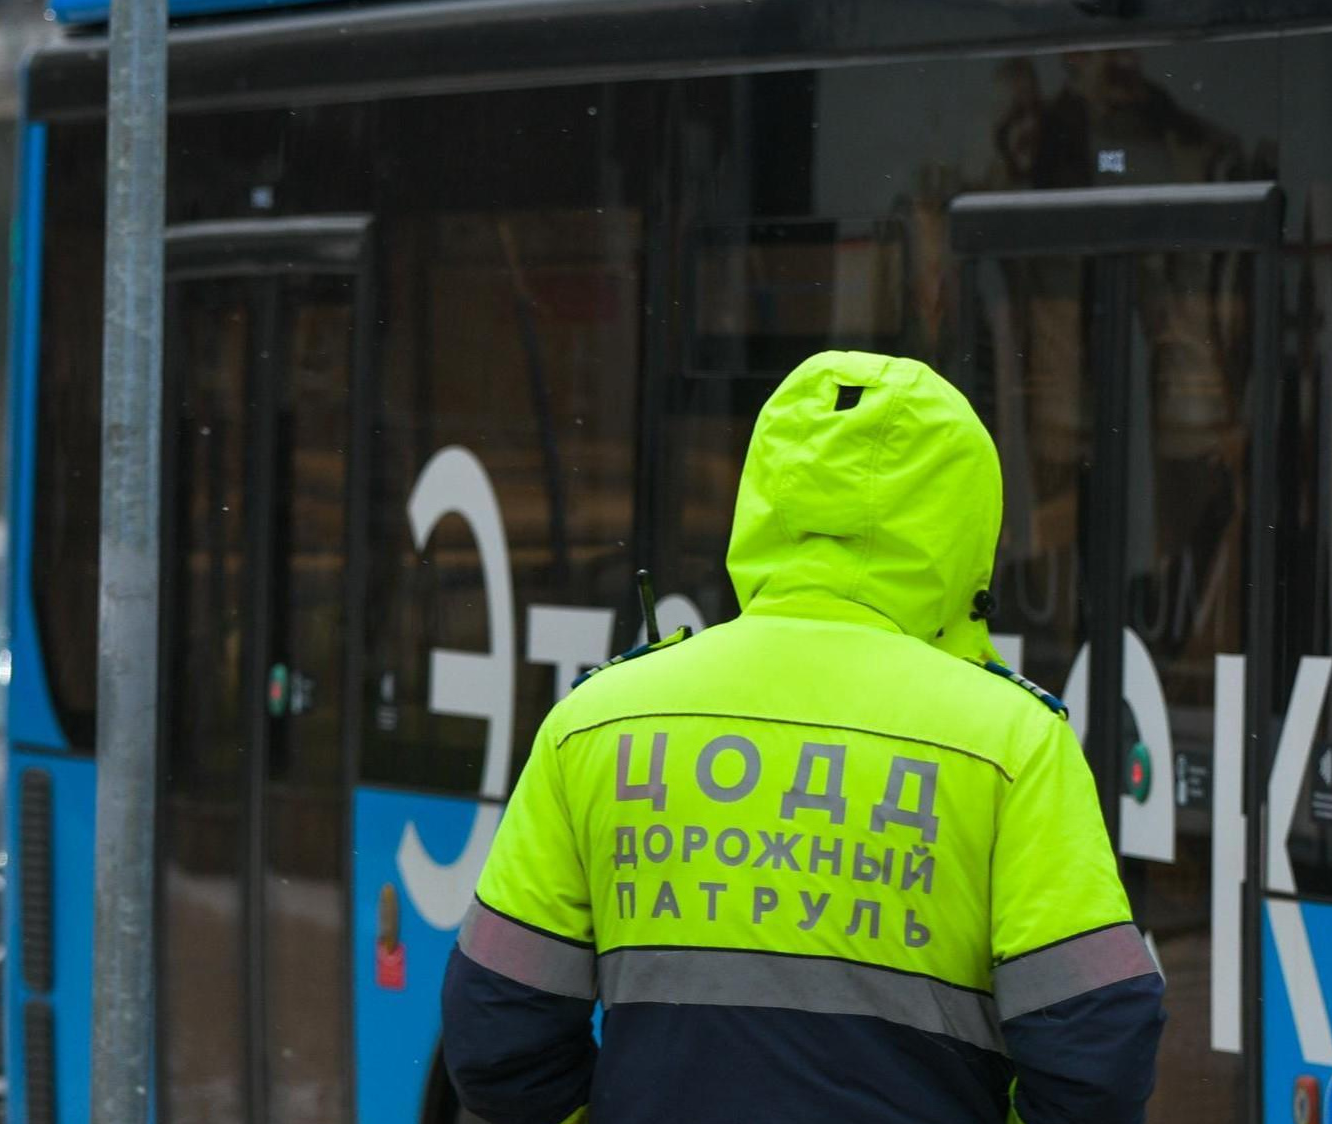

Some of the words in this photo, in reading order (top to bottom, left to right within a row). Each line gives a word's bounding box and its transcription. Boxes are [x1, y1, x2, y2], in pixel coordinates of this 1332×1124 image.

[615, 731, 939, 844] ЦОДД
[613, 823, 936, 895] ДОРОЖНЫЙ
[615, 881, 931, 948] ПАТРУЛЬ
